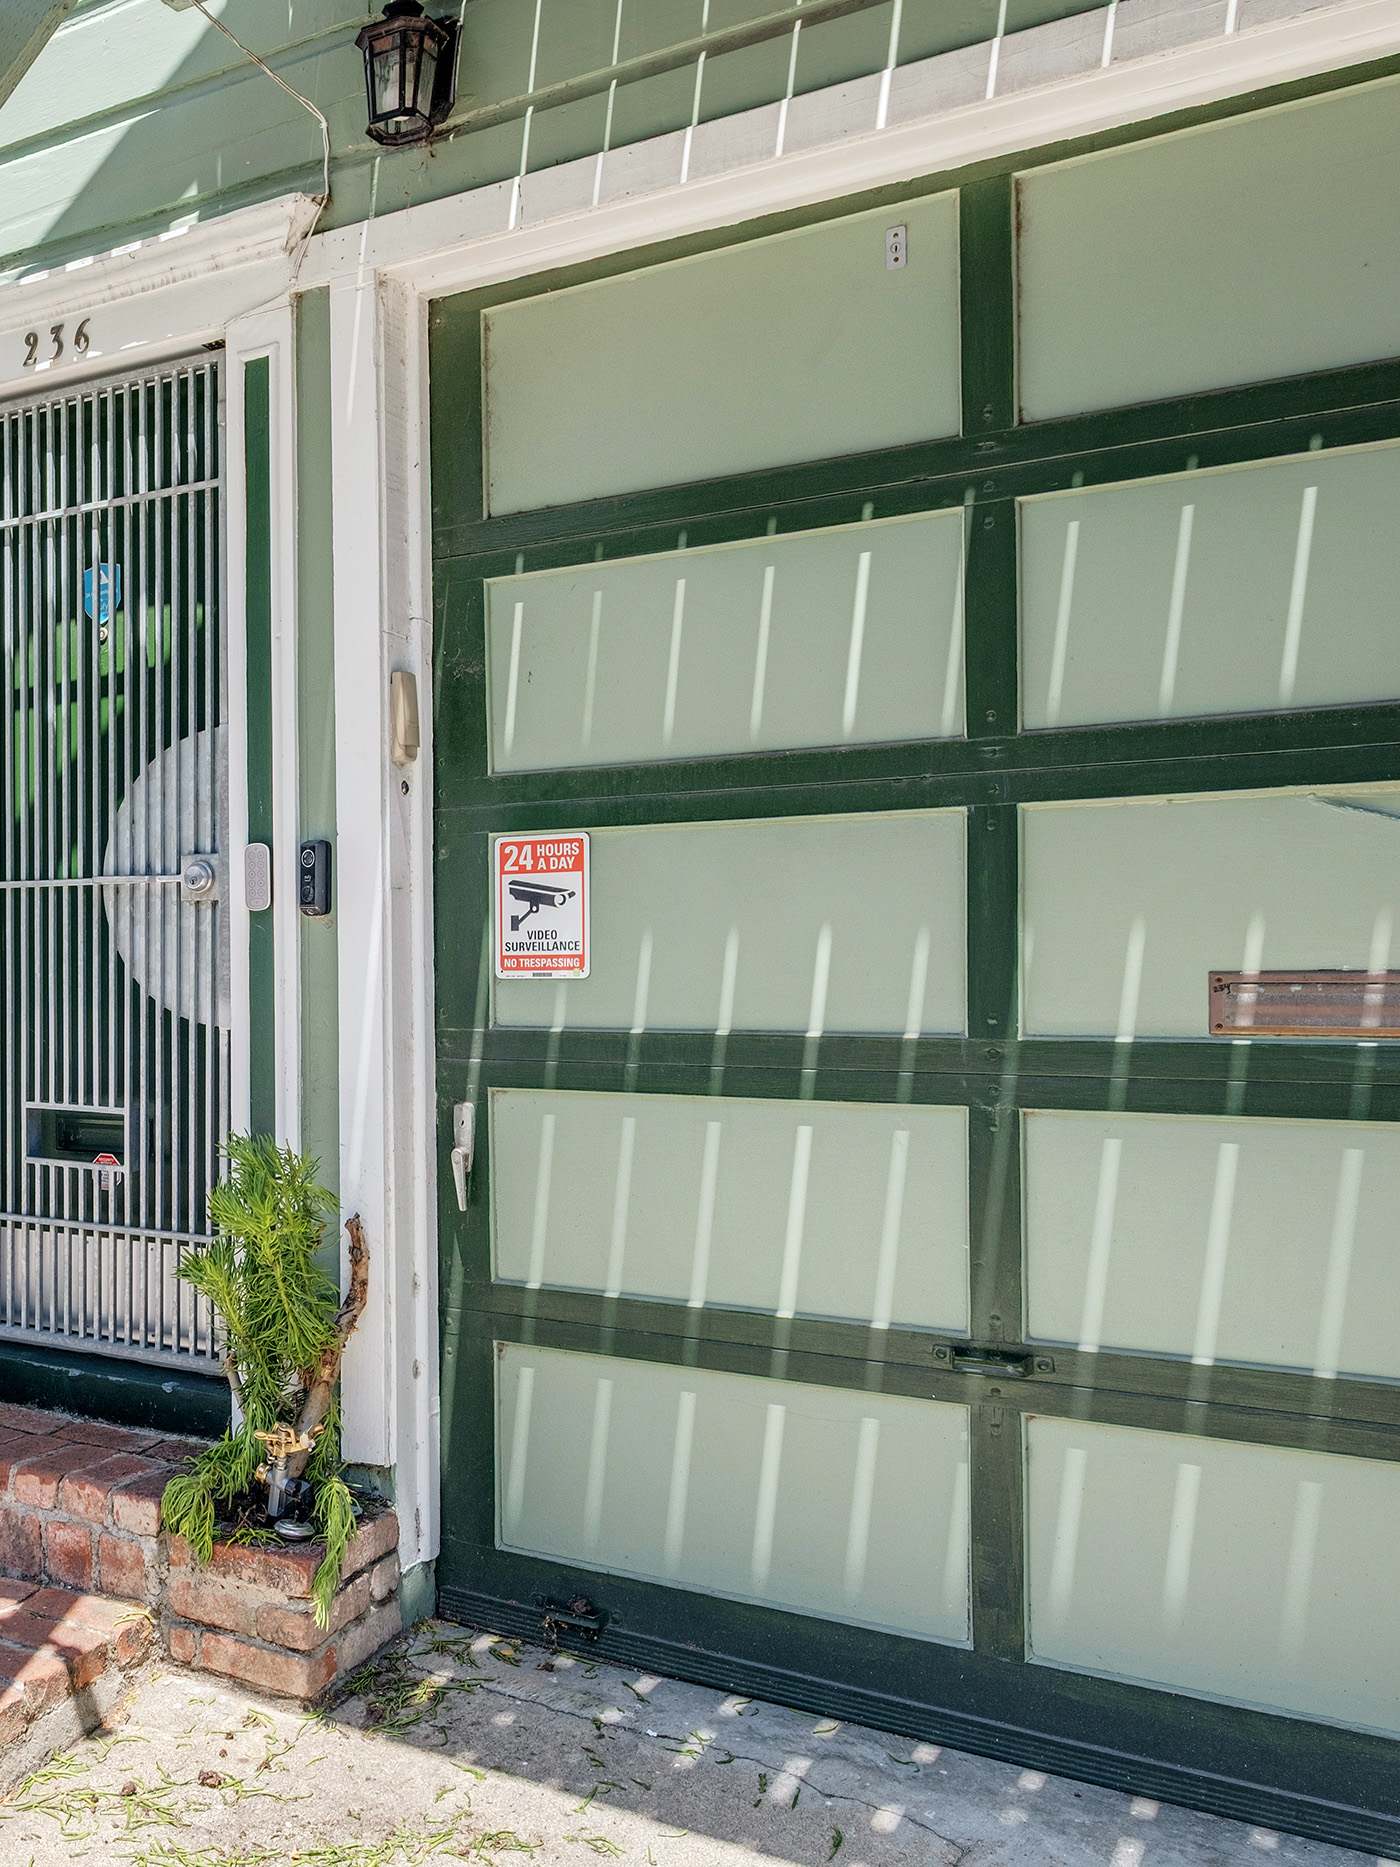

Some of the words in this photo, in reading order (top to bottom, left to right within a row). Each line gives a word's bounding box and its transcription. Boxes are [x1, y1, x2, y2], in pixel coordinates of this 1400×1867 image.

[22, 317, 91, 367] 236
[504, 844, 534, 872] 24
[537, 842, 580, 857] HOURS
[537, 858, 547, 870] A
[550, 856, 576, 870] DAY
[527, 929, 558, 940] VIDEO
[504, 940, 580, 952] SURVEILLANCE
[504, 958, 517, 968] NO
[519, 957, 580, 968] TRESPASSING
